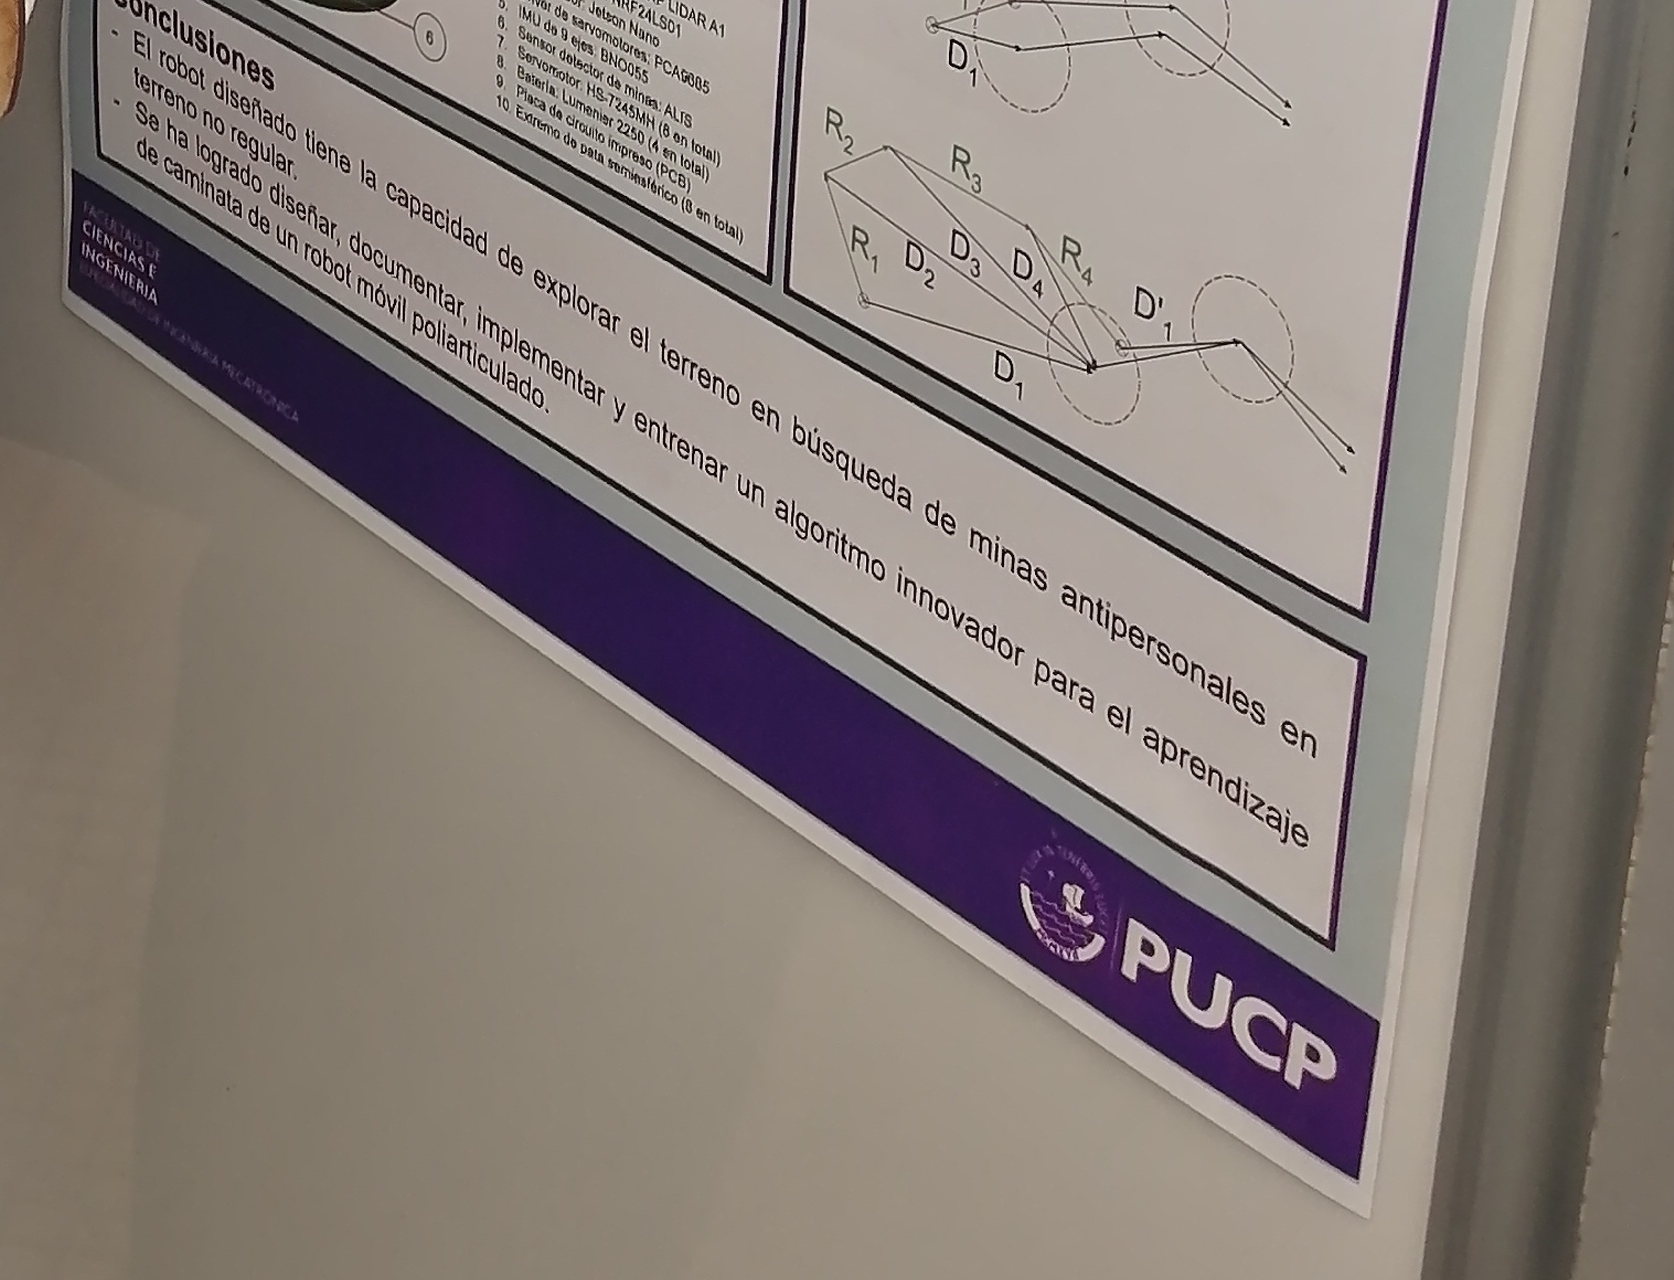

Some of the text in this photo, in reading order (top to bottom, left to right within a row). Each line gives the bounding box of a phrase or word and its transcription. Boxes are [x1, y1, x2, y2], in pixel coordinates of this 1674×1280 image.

[668, 0, 707, 30] LIDAR
[709, 19, 725, 38] A1
[134, 67, 297, 180] terreno no regular.
[82, 220, 145, 273] CIENCIAS
[137, 137, 549, 414] de caminata de un robot móvil poliarticulado.
[134, 30, 1317, 759] El robot diseñado tiene la capacidad de explorar el terreno en búsqueda de minas antipersonales en
[1121, 918, 1337, 1090] PUCP
